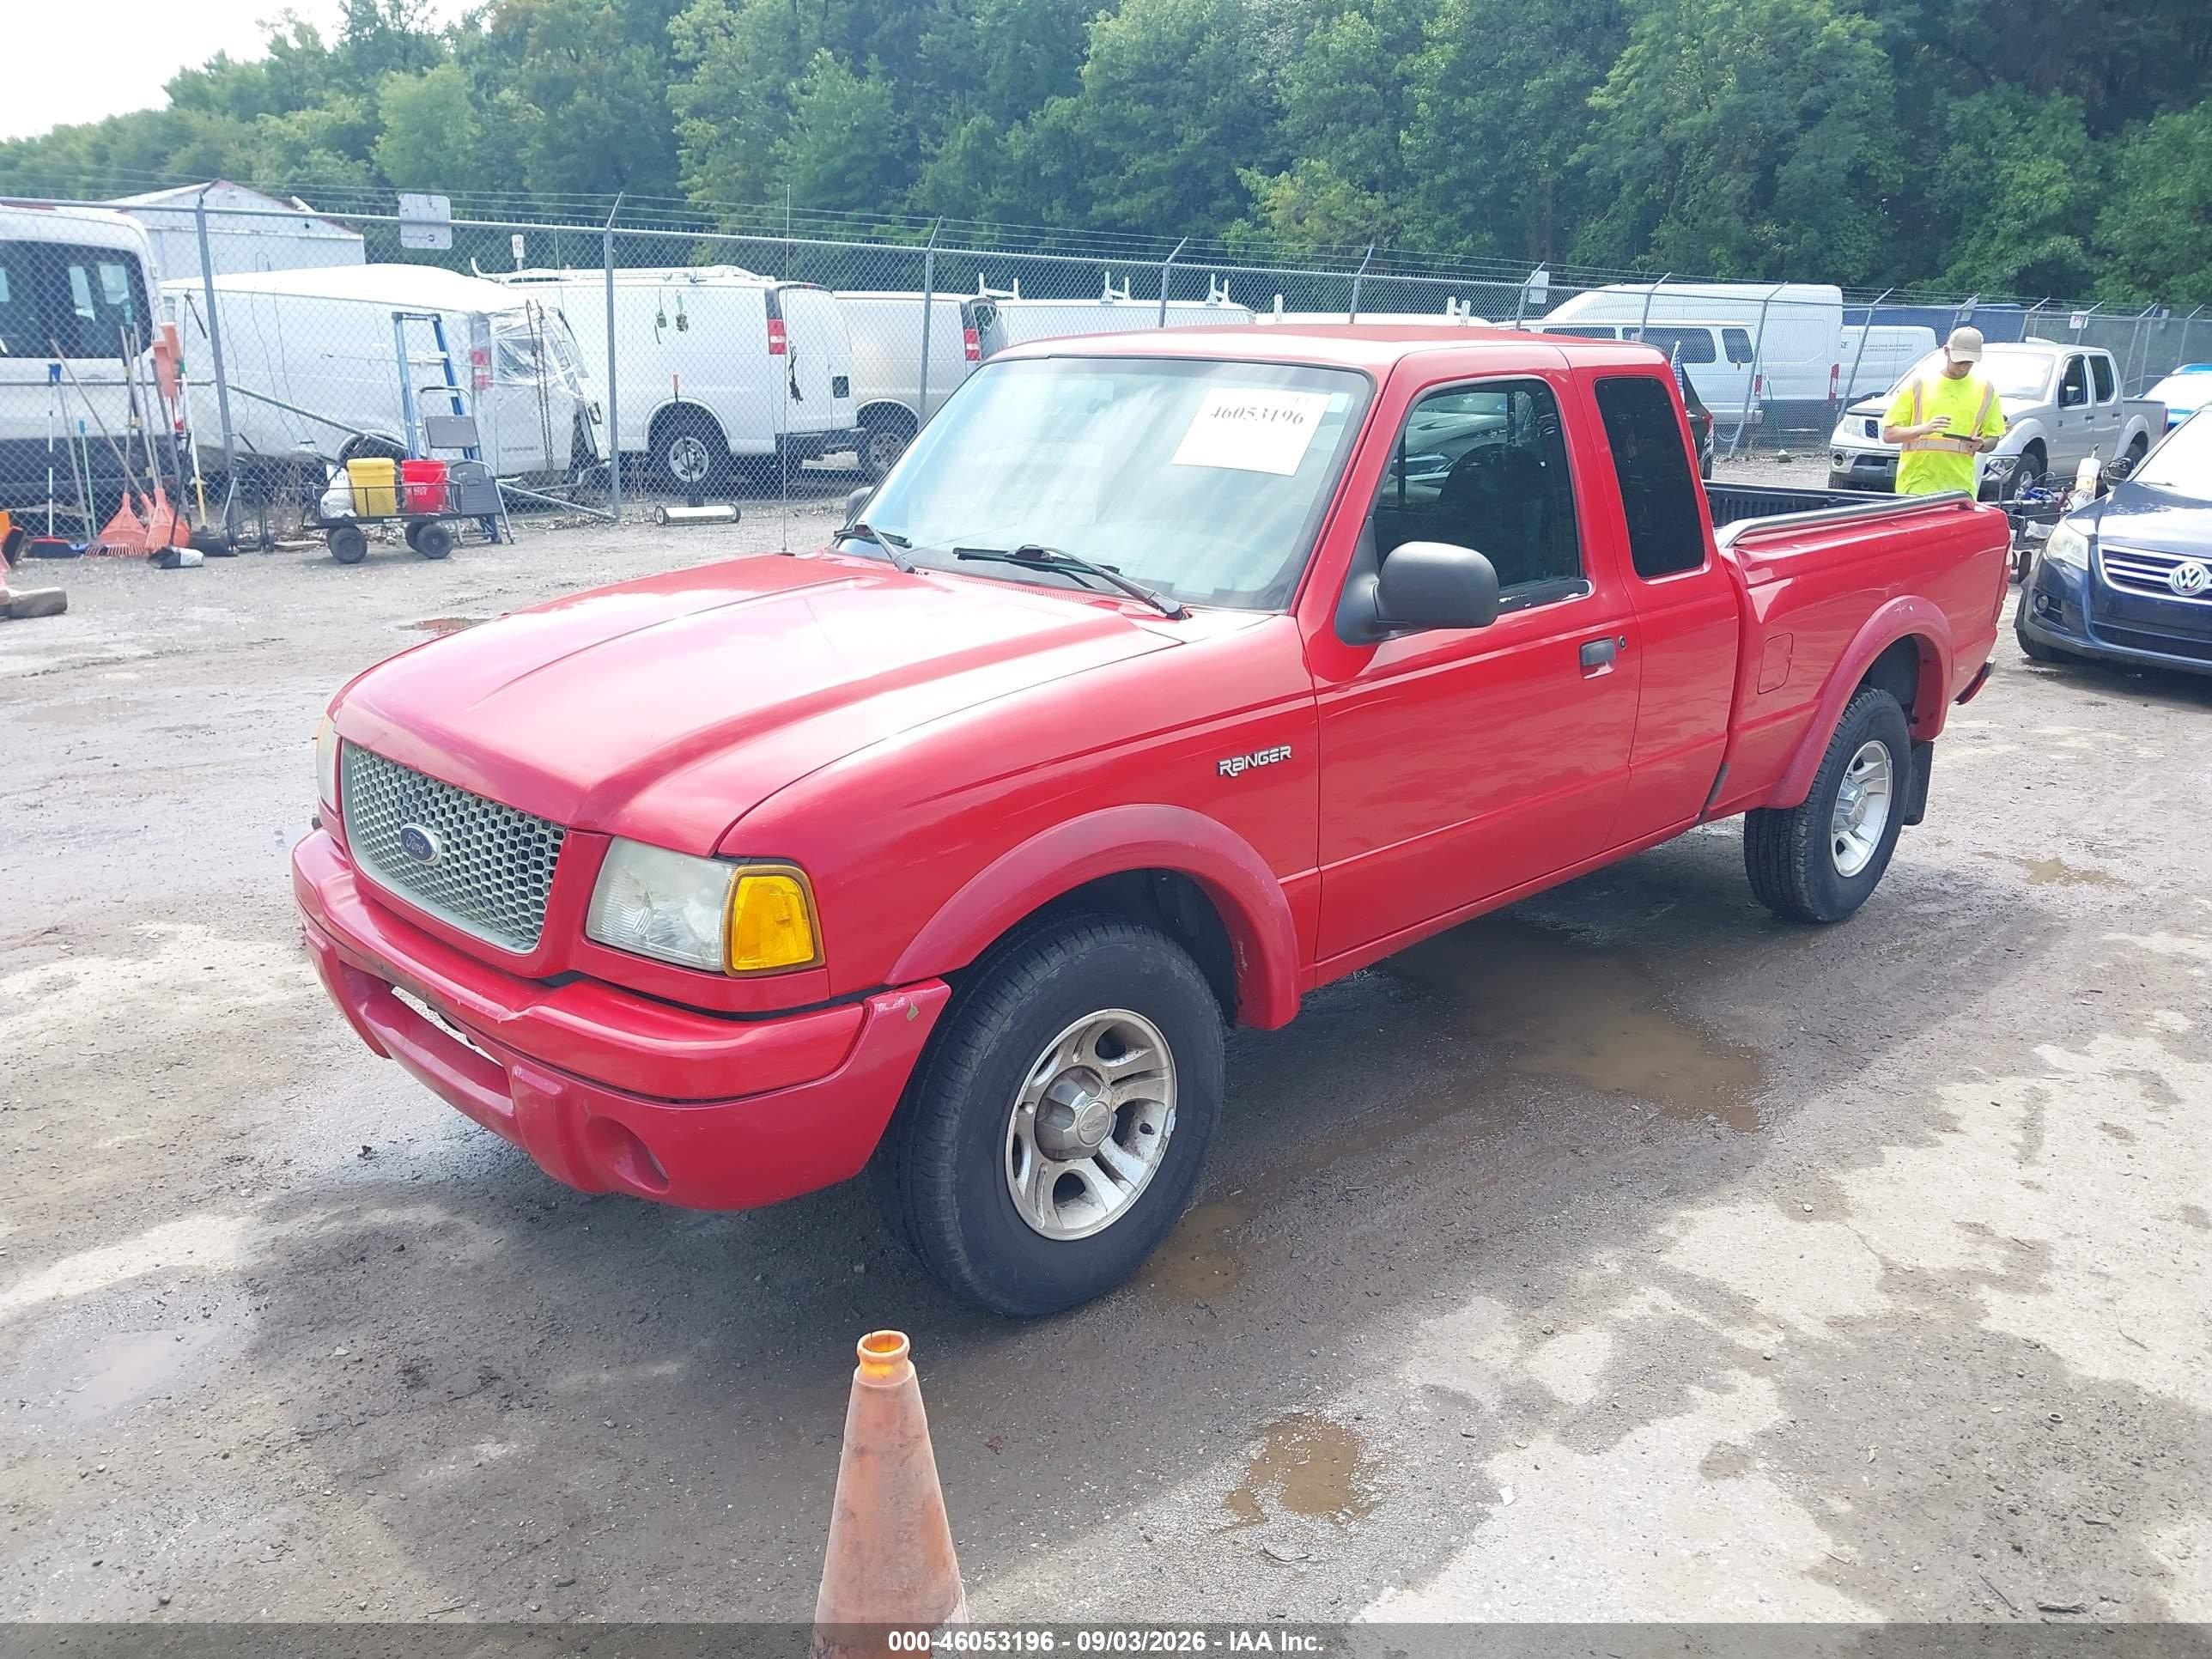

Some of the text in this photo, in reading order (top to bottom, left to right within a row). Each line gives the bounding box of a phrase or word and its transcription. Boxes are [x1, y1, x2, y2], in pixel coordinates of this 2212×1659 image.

[1210, 405, 1304, 425] 46053196
[1218, 744, 1292, 777] RANGER
[405, 831, 426, 854] Ford
